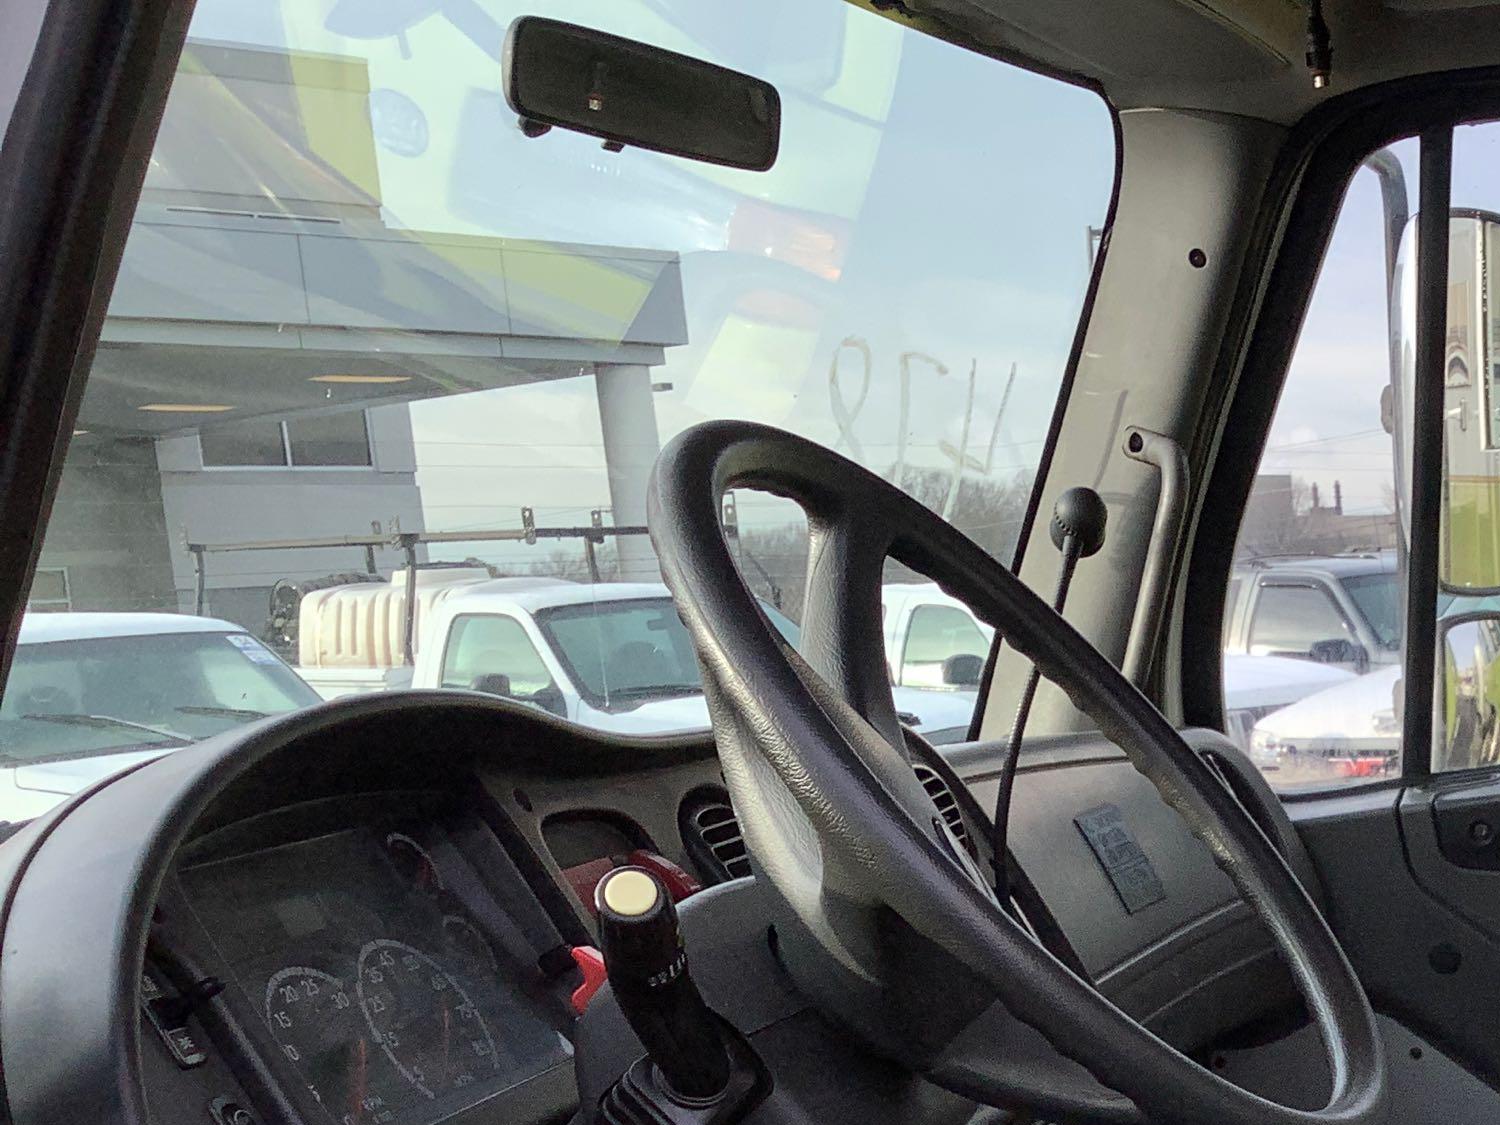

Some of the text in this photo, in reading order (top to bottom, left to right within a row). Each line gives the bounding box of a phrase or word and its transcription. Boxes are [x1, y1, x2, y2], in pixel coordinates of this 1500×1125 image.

[280, 985, 299, 1003] 20
[301, 978, 319, 996] 25
[331, 992, 350, 1009] 30
[274, 1011, 291, 1028] 15
